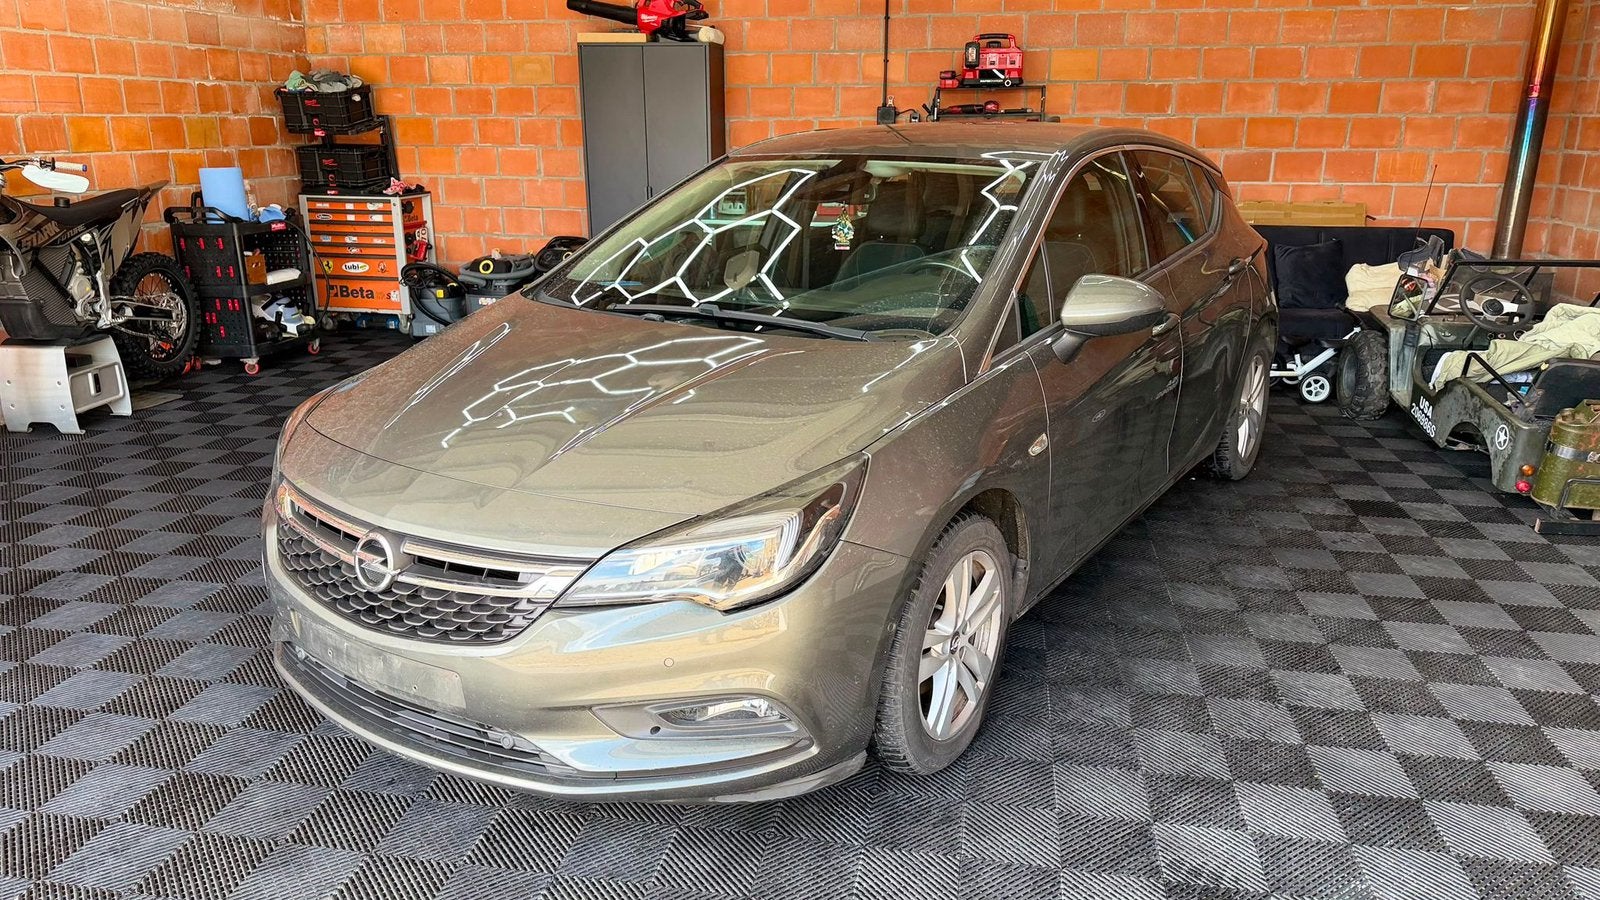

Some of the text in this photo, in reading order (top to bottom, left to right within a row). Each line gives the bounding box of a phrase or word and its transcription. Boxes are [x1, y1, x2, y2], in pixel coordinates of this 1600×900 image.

[20, 220, 60, 253] STARK
[56, 223, 87, 245] FUTURE
[344, 262, 360, 271] tubi
[340, 285, 375, 299] Beta
[1419, 395, 1433, 419] USA
